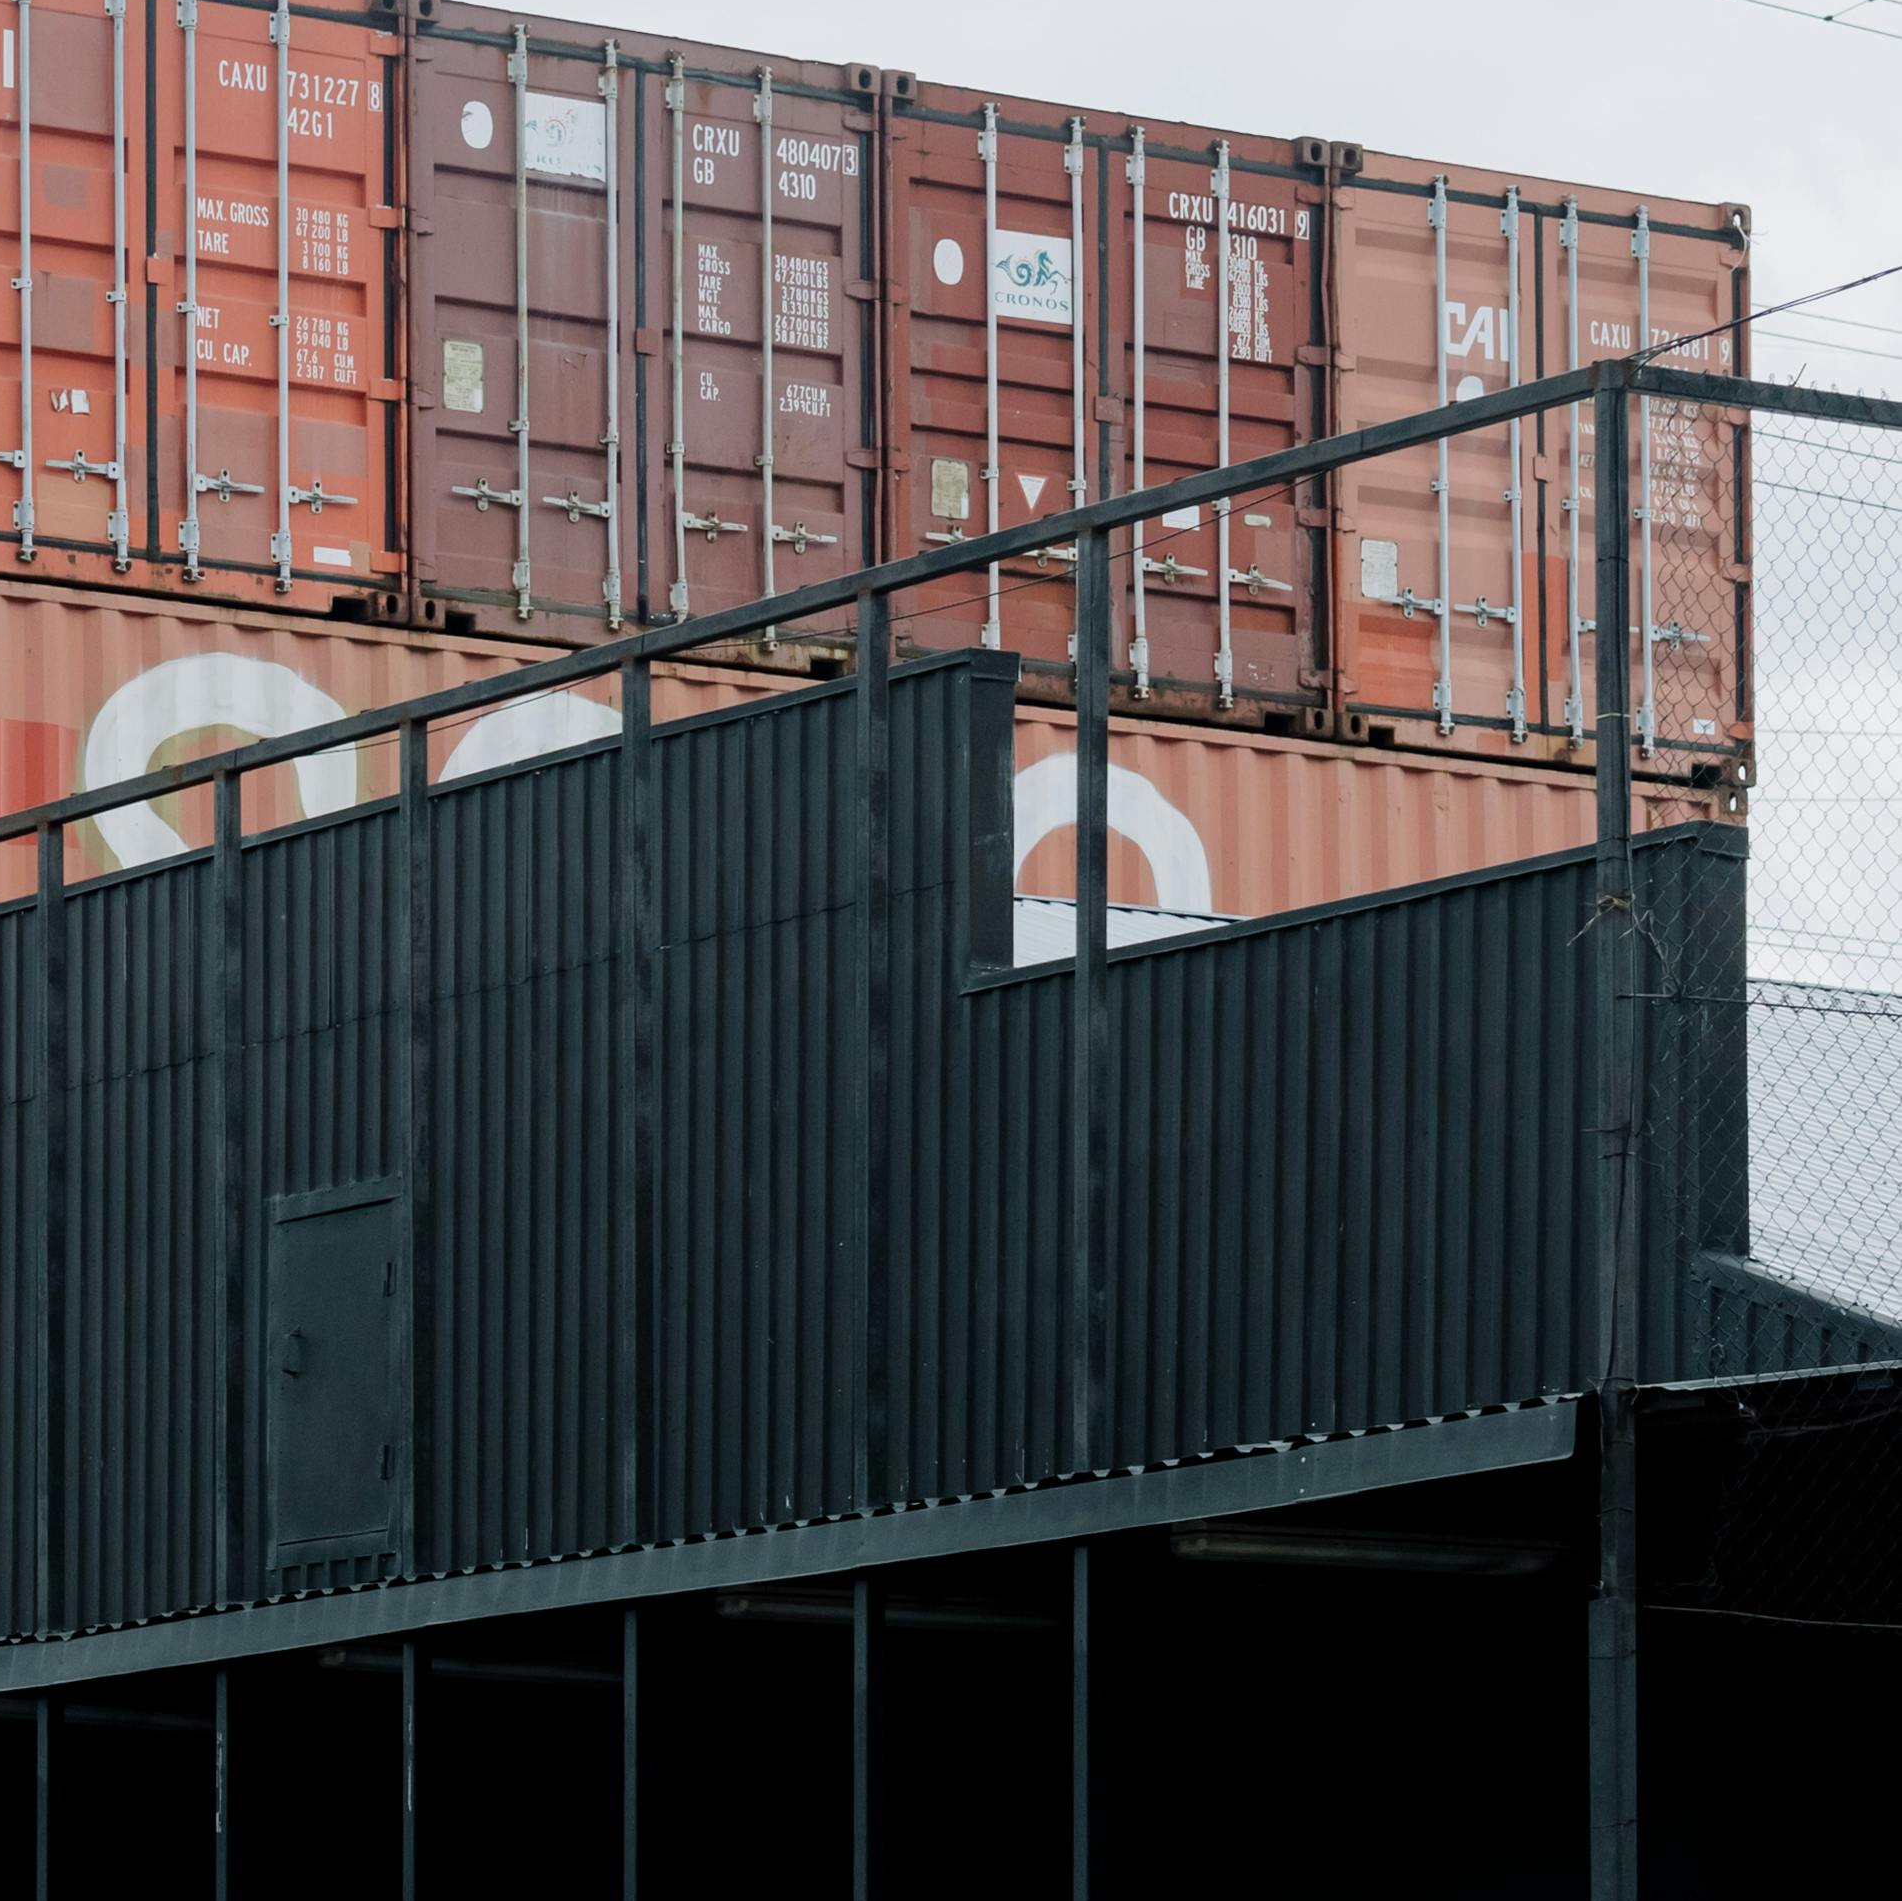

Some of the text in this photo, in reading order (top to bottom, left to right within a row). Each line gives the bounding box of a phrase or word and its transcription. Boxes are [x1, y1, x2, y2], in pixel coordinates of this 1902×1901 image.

[218, 59, 381, 111] CAXU 731227 8
[286, 106, 333, 139] 42G1
[692, 122, 857, 174] CRXU 480407 3
[693, 157, 817, 201] GB 4310
[197, 197, 349, 228] MAX. GROSS 30 480 KG
[1168, 191, 1307, 239] CRXU 416031 9
[197, 229, 349, 261] TARE 3 700 KG
[296, 223, 349, 243] 67 200 LB
[1185, 225, 1258, 260] GB 310
[336, 260, 349, 275] LB
[698, 258, 731, 276] GROSS
[698, 274, 722, 291] TARE
[698, 288, 721, 305] WGT.
[994, 291, 1069, 312] CRONOS
[196, 305, 349, 336] NET 26 780 KG
[699, 318, 732, 335] CARGO
[1444, 301, 1509, 362] CAI
[1589, 320, 1631, 349] CAXU
[196, 338, 218, 362] CU.
[223, 342, 253, 368] CAP.
[336, 336, 349, 352] LB
[700, 386, 721, 402] CAP.
